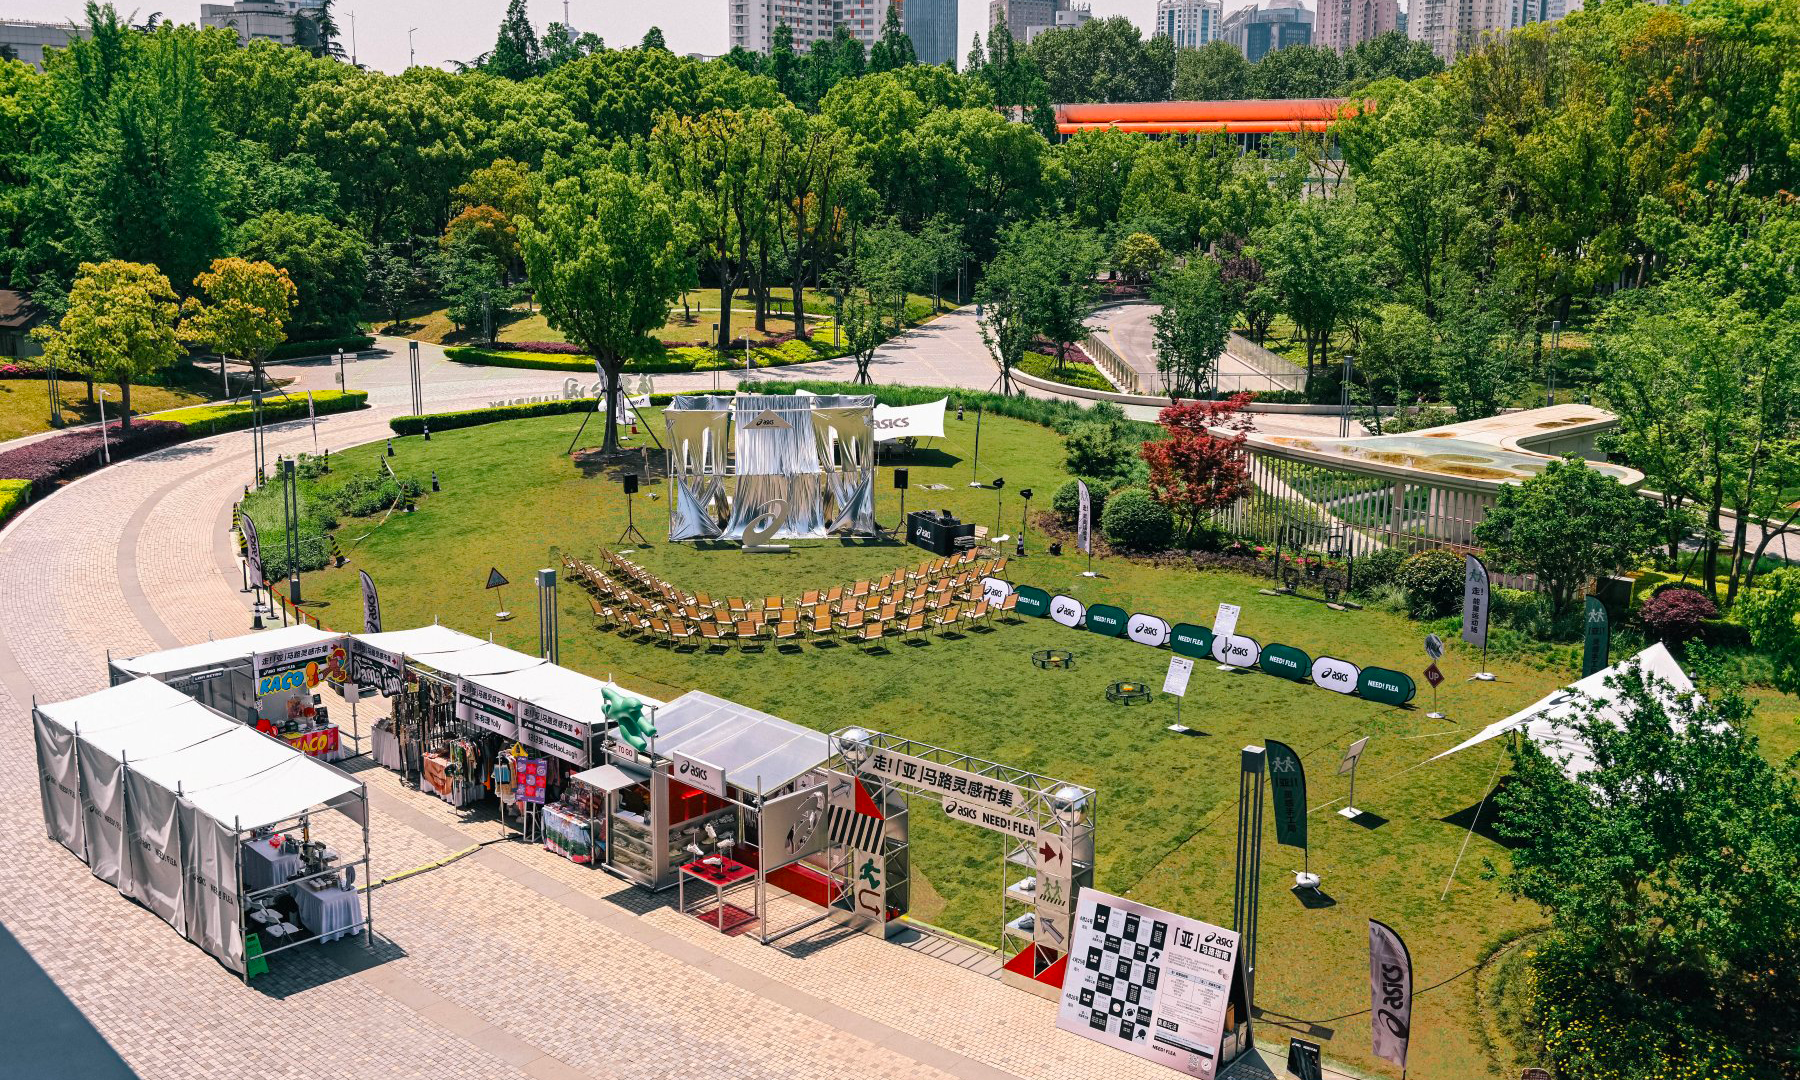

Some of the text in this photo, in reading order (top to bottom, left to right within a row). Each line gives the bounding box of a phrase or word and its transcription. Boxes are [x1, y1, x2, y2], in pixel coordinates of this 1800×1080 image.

[991, 588, 1003, 598] asics
[1471, 587, 1484, 596] 走!
[366, 594, 378, 621] asics
[1030, 599, 1040, 607] FLEA
[1064, 608, 1075, 618] asics
[1093, 615, 1117, 626] NEED! FLEA
[1143, 626, 1158, 637] asics
[1177, 635, 1204, 647] NEED! FLEA
[262, 645, 329, 666] 走!「亚」马路灵感市集
[1232, 647, 1249, 657] asics
[1269, 655, 1298, 669] NEED! FLEA
[1331, 670, 1349, 683] asics
[1428, 671, 1440, 681] UP
[259, 671, 305, 695] KACO
[1367, 679, 1399, 693] NEED! FLEA
[618, 746, 633, 757] TO GO
[690, 766, 708, 781] asics
[873, 755, 1014, 808] 走!「亚」马路灵感市集
[957, 805, 1036, 838] asics NEED! FLEA
[1173, 927, 1200, 952] 「亚」
[1216, 936, 1234, 948] asics
[1382, 964, 1404, 1010] asics
[1152, 1045, 1177, 1057] NEED! FLEA
